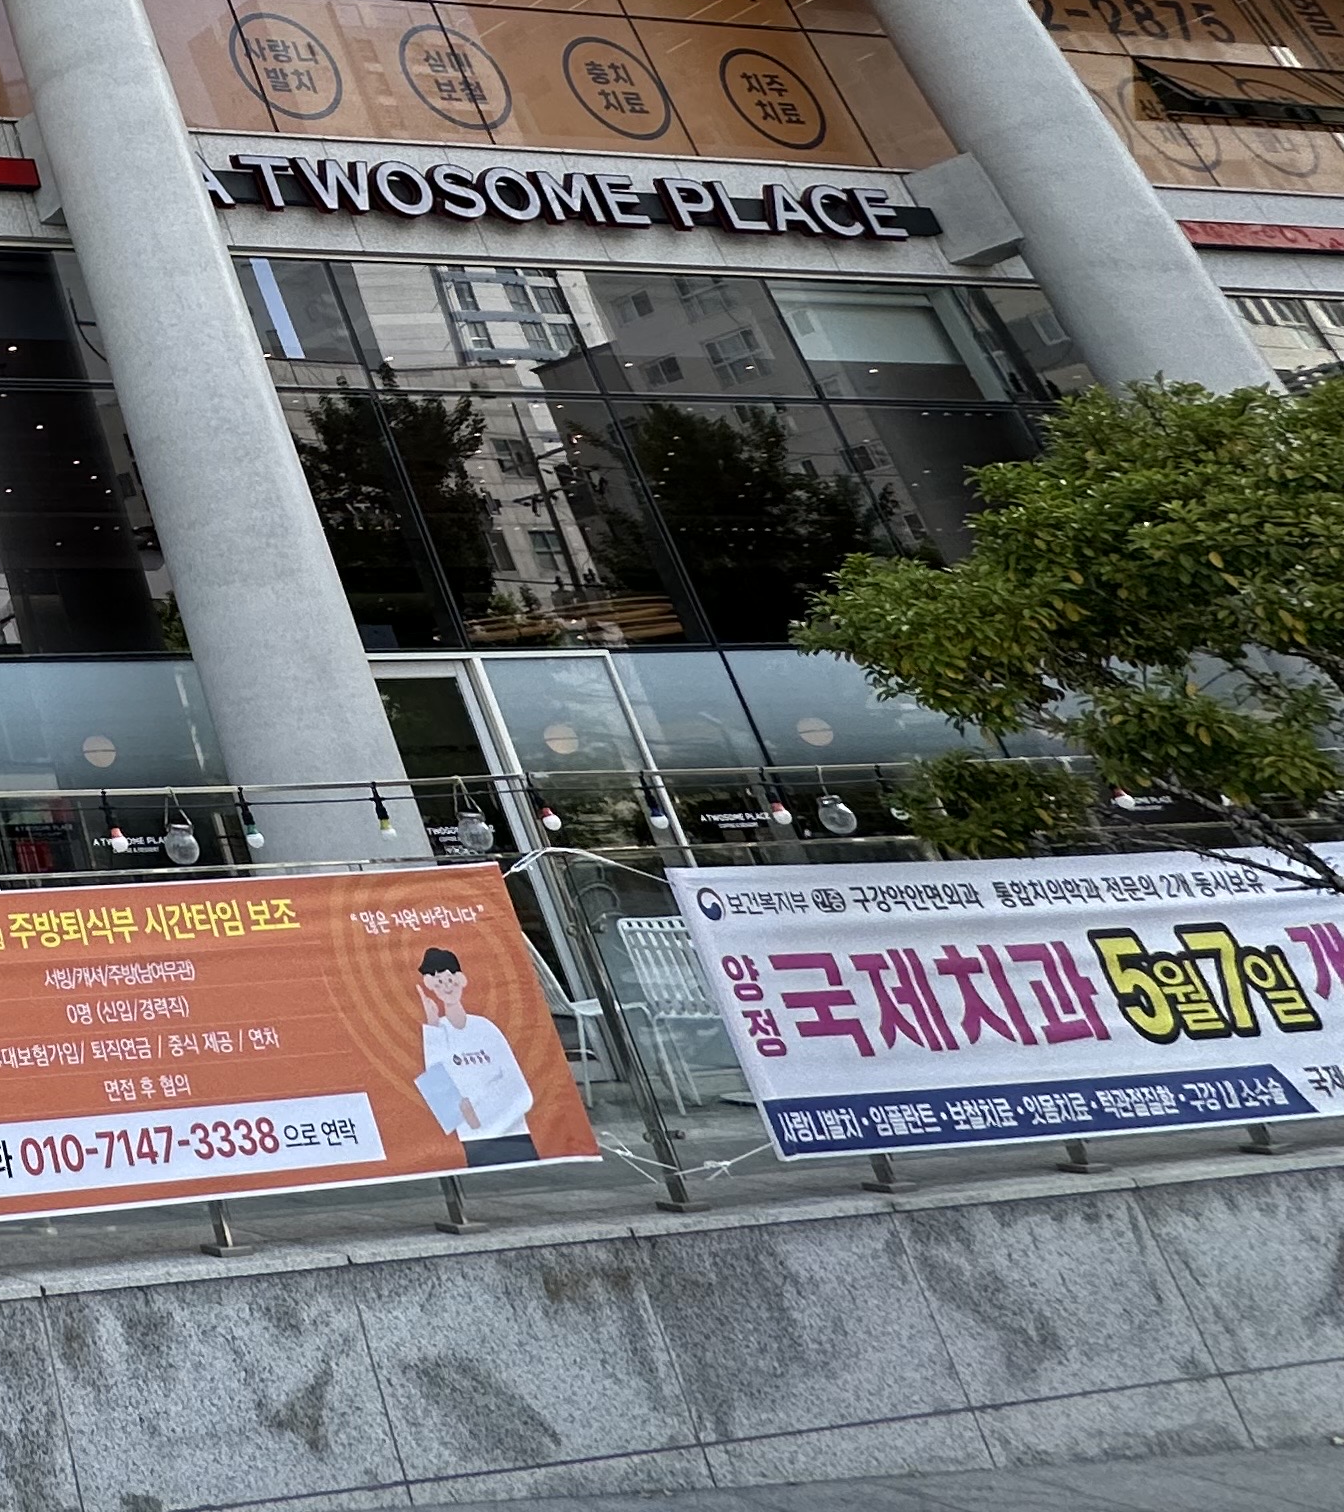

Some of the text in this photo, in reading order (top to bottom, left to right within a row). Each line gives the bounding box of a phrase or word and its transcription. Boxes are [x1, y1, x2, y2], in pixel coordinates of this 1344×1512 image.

[244, 38, 320, 65] 사랑니
[424, 48, 476, 76] 심미
[264, 66, 318, 94] 발치
[584, 60, 635, 87] 충치
[740, 71, 788, 99] 치주
[598, 88, 650, 115] 치료
[754, 100, 806, 126] 치료
[234, 154, 652, 229] TWOSOME
[657, 177, 910, 240] PLACE
[726, 891, 809, 914] 보건복지부
[849, 882, 985, 913] 구강악안면외과
[992, 877, 1106, 908] 통합치의학과
[1101, 874, 1162, 902] 전문의
[1160, 872, 1195, 899] 2개
[1193, 868, 1266, 897] 동시보유
[8, 910, 139, 951] 주방퇴식부
[145, 903, 242, 943] 시간타임
[247, 899, 301, 932] 보조
[391, 907, 421, 931] 지원
[97, 995, 189, 1024] (신입/경력직)
[722, 955, 788, 1059] 양정
[767, 939, 1112, 1059] 국제치과
[91, 1037, 152, 1063] 퇴직연금
[168, 1032, 199, 1057] 중식
[202, 1030, 234, 1054] 제공
[249, 1027, 280, 1050] 연차
[104, 1078, 136, 1102] 면접
[140, 1076, 155, 1100] 후
[160, 1074, 191, 1098] 협의
[20, 1116, 281, 1179] 010-7147-3338
[285, 1124, 317, 1148] 으로
[320, 1118, 360, 1147] 연락
